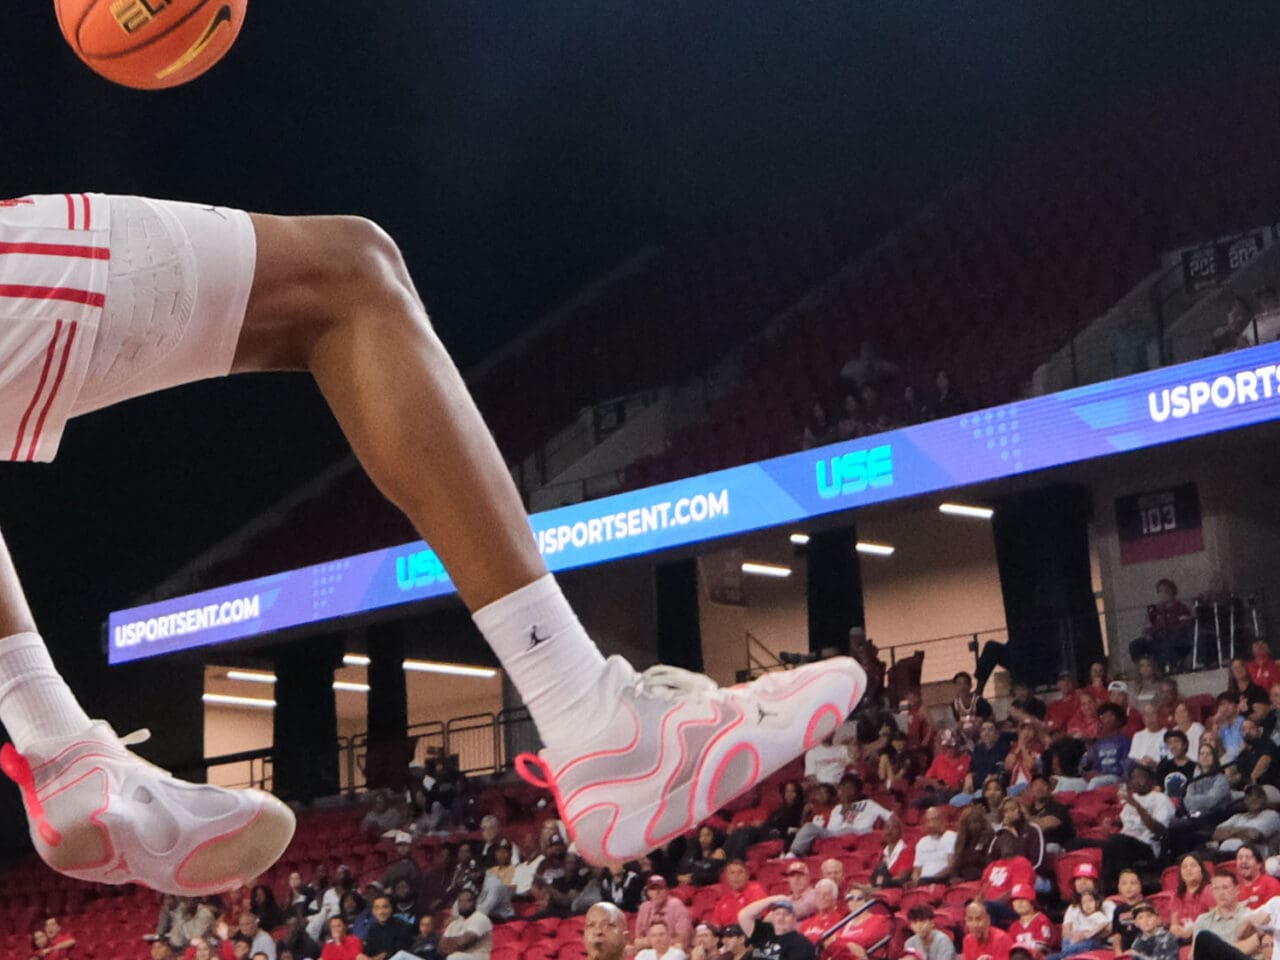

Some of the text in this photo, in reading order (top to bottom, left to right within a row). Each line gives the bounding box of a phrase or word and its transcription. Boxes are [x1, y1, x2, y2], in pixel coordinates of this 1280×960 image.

[816, 444, 894, 499] USE
[1140, 505, 1177, 535] 103
[115, 595, 260, 648] USPORTSENT.COM
